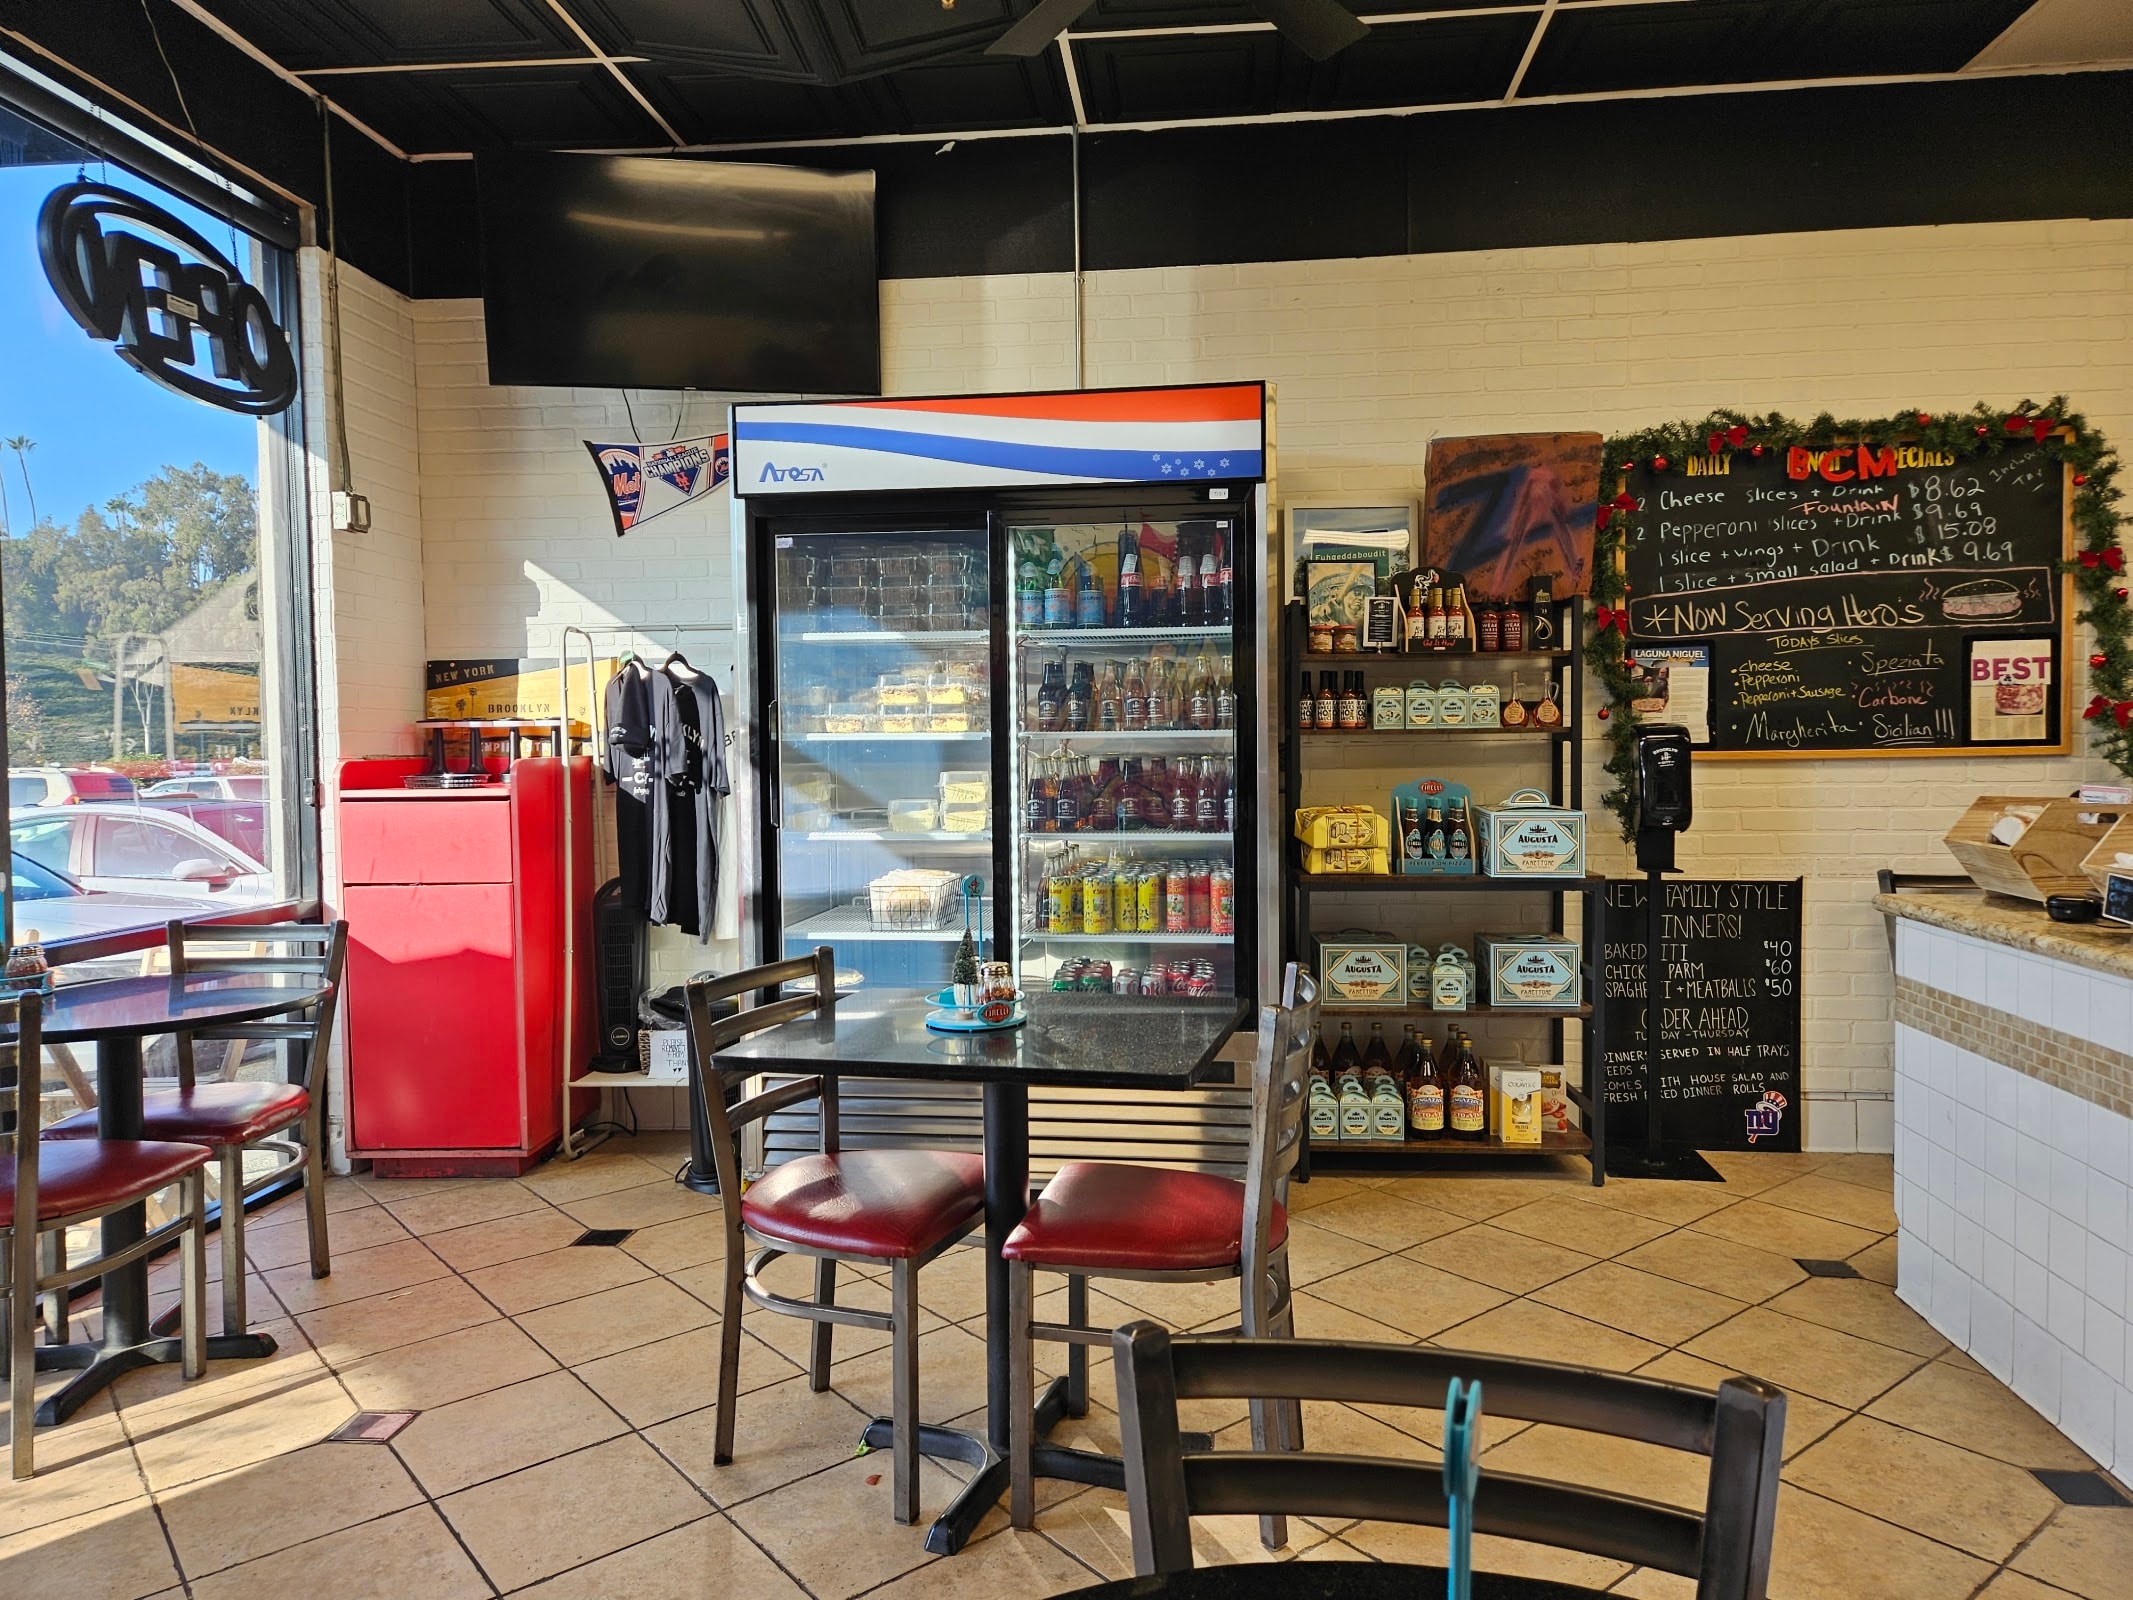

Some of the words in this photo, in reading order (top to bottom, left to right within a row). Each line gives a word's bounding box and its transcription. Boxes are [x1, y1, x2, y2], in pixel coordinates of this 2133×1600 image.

[643, 449, 710, 478] CHAMPIONS
[1686, 454, 1732, 477] DAILY
[1877, 446, 1955, 469] ECIALS
[1789, 446, 1897, 482] BCM
[1637, 497, 1646, 512] 2
[1660, 490, 1725, 510] Cheese
[1832, 485, 1885, 497] Drink
[1636, 527, 1646, 541] 2
[1660, 520, 1757, 544] Pepperoni
[1315, 549, 1387, 562] Fuhgeddaboudit
[1671, 550, 1712, 566] slice
[1811, 534, 1881, 558] Drink
[1674, 573, 1718, 592] slice
[1744, 566, 1798, 584] small
[1809, 558, 1858, 577] salad
[1731, 600, 1836, 634] Serving
[1635, 650, 1671, 658] LAGUNA
[1672, 650, 1706, 659] NIGUEL
[1861, 638, 1945, 676] Speziata
[435, 670, 459, 683] NEW
[463, 664, 496, 679] YORK
[1972, 656, 2051, 681] BEST
[1741, 674, 1800, 692] Pepperoni
[487, 703, 551, 714] BROOKLYN
[1745, 710, 1857, 748] Margherita
[1518, 834, 1558, 843] AUGUSTA
[1666, 884, 1722, 909] FAMILY
[1729, 884, 1789, 910] STYLE
[1660, 913, 1743, 940] INNERS!
[1604, 943, 1648, 961] BAKED
[1660, 944, 1688, 962] ITI
[1345, 964, 1382, 974] AUGUSTA
[1517, 964, 1555, 974] AUGUSTA
[1668, 962, 1705, 980] PARM
[1698, 1007, 1749, 1031] AHEAD
[1707, 1047, 1721, 1057] IN
[1728, 1046, 1752, 1057] HALF
[1756, 1044, 1791, 1058] TRAYS
[666, 1059, 687, 1067] THAN
[1660, 1075, 1681, 1088] ITH
[1690, 1073, 1726, 1085] HOUSE
[1731, 1072, 1764, 1083] SALAD
[1769, 1072, 1790, 1081] AND
[1683, 1085, 1722, 1099] DINNER
[1733, 1083, 1766, 1095] ROLLS
